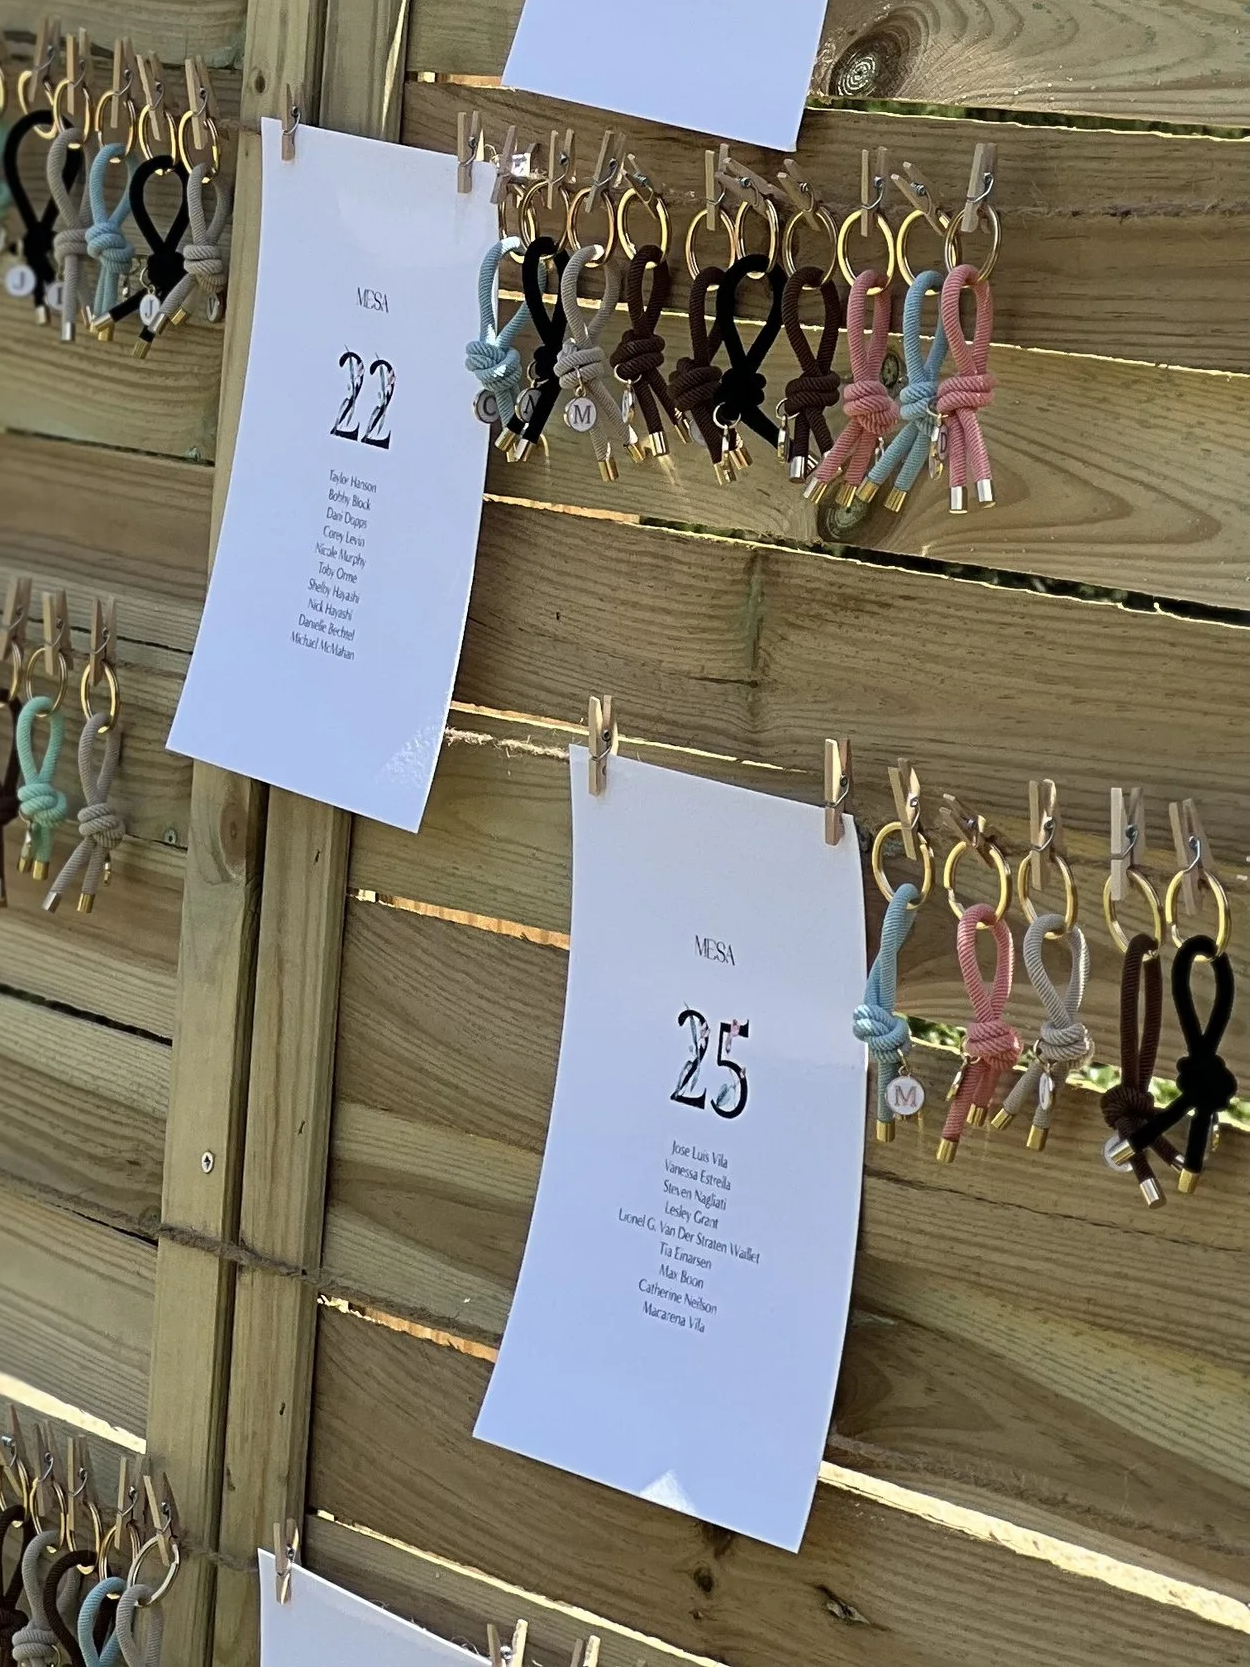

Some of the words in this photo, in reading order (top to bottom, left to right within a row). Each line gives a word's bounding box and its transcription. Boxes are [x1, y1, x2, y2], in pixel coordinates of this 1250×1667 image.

[13, 272, 25, 289] J
[145, 300, 154, 318] J
[357, 287, 389, 313] MESA
[330, 344, 396, 450] 22
[573, 404, 591, 424] M
[940, 432, 948, 453] D
[329, 470, 349, 485] Taylor
[329, 489, 351, 505] Bobby
[326, 507, 343, 521] Dani
[322, 526, 344, 543] Corey
[315, 542, 338, 558] Nicole
[339, 548, 367, 570] Murphy
[319, 562, 335, 578] Toby
[332, 585, 360, 604] Hayashi
[307, 597, 323, 613] Nick
[325, 602, 353, 621] Hayashi
[290, 631, 319, 650] Michael
[695, 935, 736, 966] MESA
[670, 1000, 750, 1119] 25
[894, 1085, 917, 1107] M
[692, 1146, 709, 1164] Luis
[712, 1152, 728, 1169] Vila
[664, 1159, 698, 1181] Vanessa
[700, 1170, 731, 1191] Estrella
[663, 1179, 692, 1199] Steven
[664, 1201, 692, 1223] Lesley
[693, 1210, 719, 1229] Grant
[618, 1208, 646, 1227] Lionel
[647, 1218, 657, 1232] G.
[660, 1220, 676, 1237] Van
[677, 1227, 695, 1243] Der
[696, 1232, 727, 1253] Straten
[660, 1241, 672, 1258] Tia
[659, 1264, 677, 1279] Max
[681, 1270, 704, 1289] Boon
[639, 1278, 683, 1303] Catherine
[643, 1301, 686, 1327] Macarena
[688, 1315, 706, 1333] Vila
